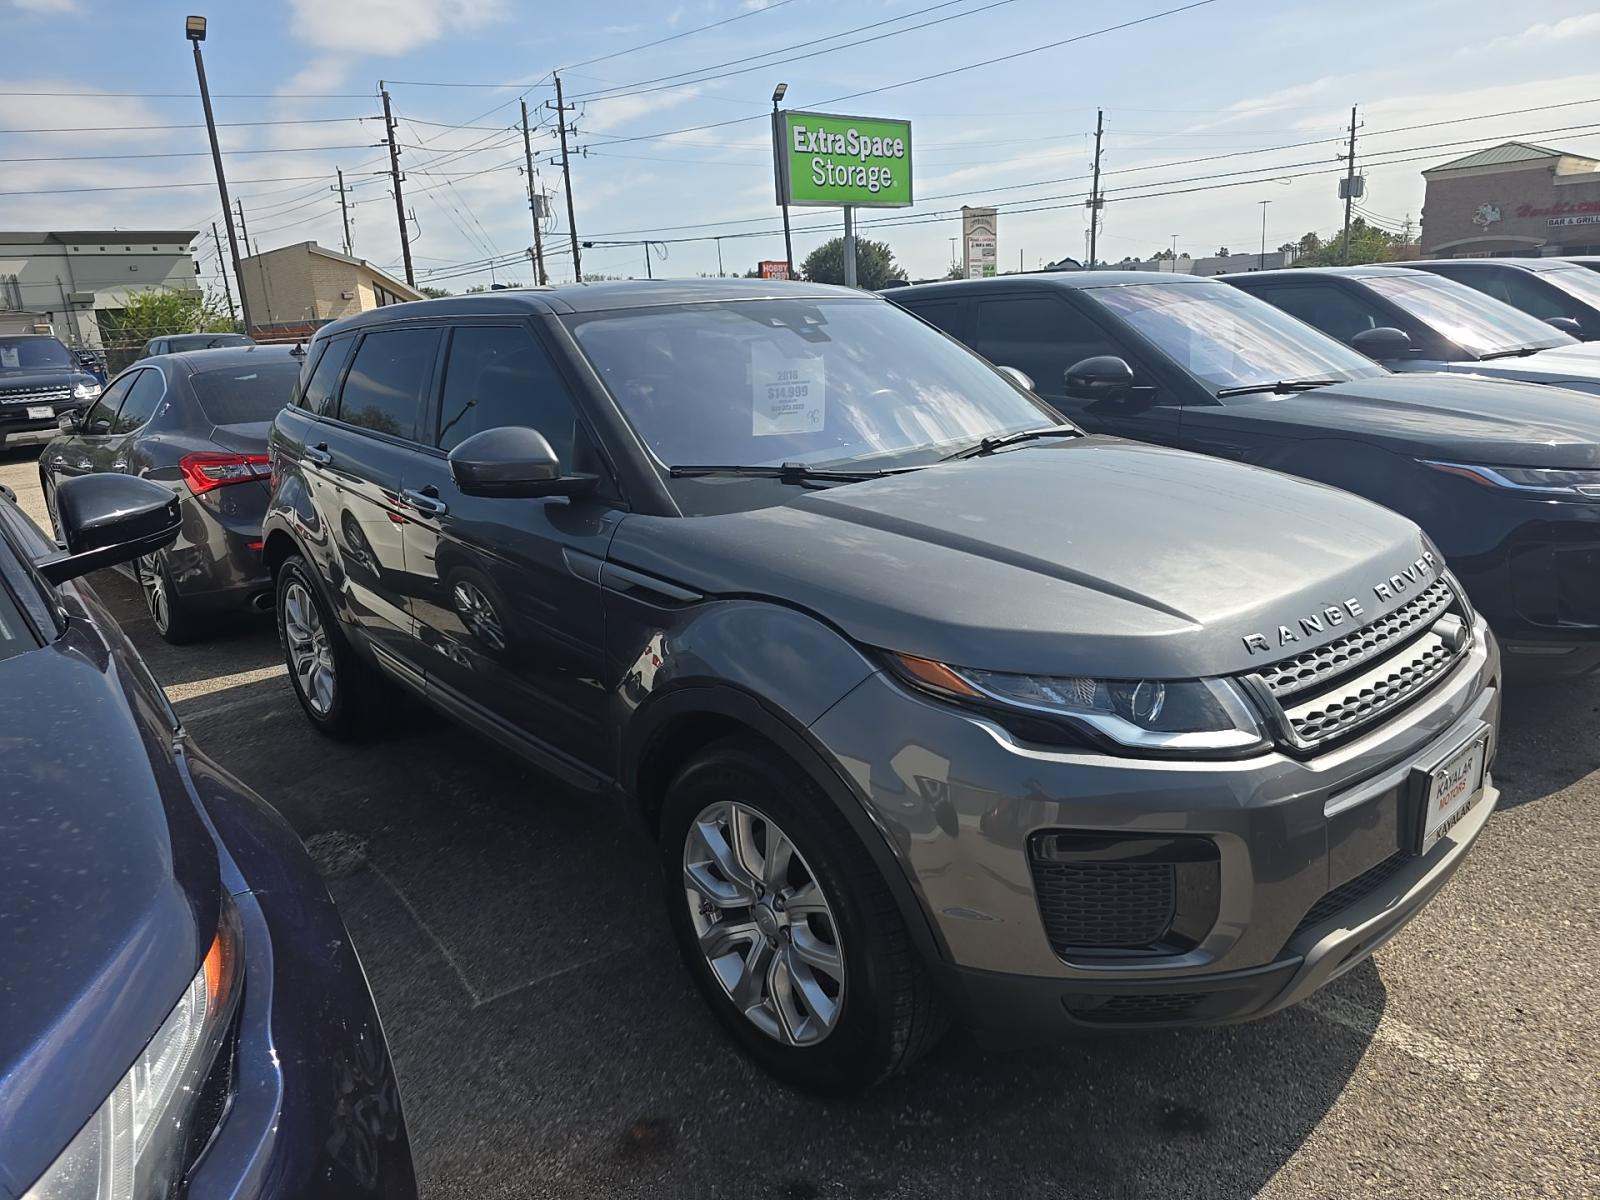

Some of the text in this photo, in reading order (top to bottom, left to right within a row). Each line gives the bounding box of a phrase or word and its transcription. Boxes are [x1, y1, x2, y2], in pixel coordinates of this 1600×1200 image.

[811, 156, 893, 193] Storage
[1549, 218, 1565, 226] BAR
[763, 264, 788, 273] HOBBY
[1242, 551, 1437, 655] RANGE ROVER
[1436, 757, 1473, 800] KAYALAR
[1440, 778, 1466, 811] MOTORS
